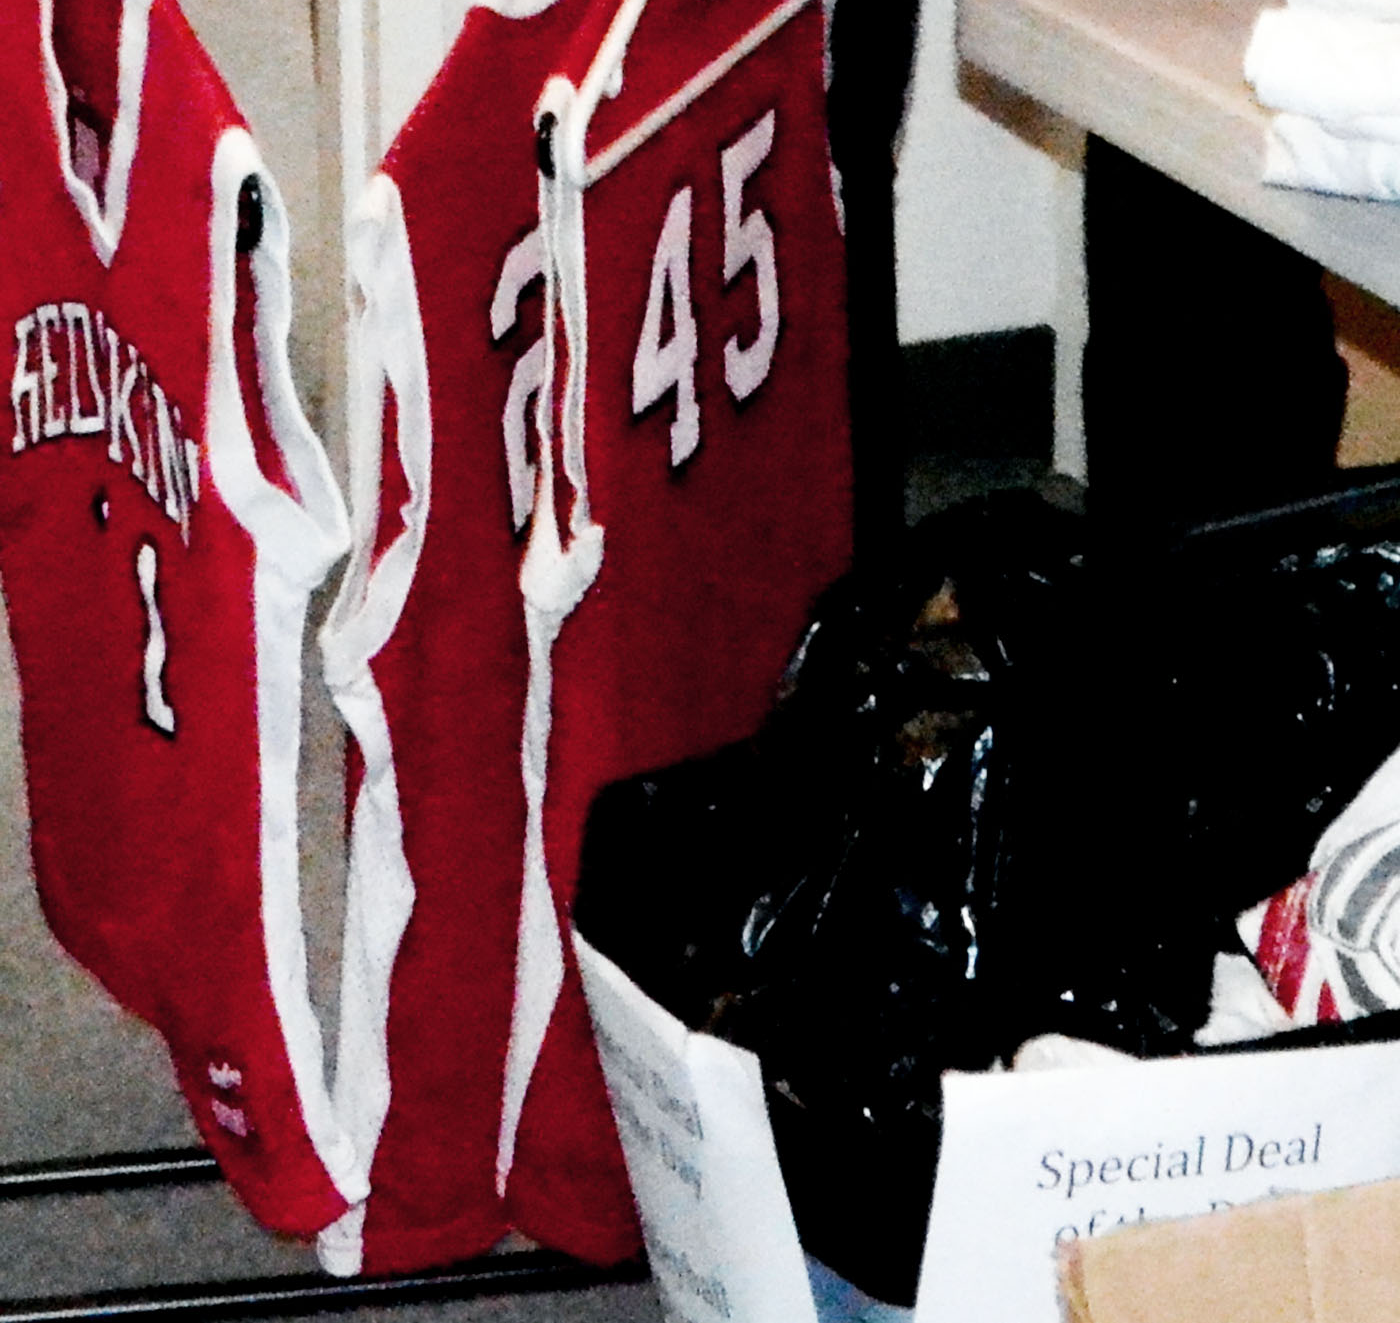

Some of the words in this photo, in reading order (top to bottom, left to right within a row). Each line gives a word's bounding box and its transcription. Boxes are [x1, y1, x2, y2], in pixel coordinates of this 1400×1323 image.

[632, 107, 782, 469] 45
[10, 301, 200, 546] REDKIN
[1036, 1134, 1206, 1199] Special
[1224, 1122, 1322, 1173] Deal
